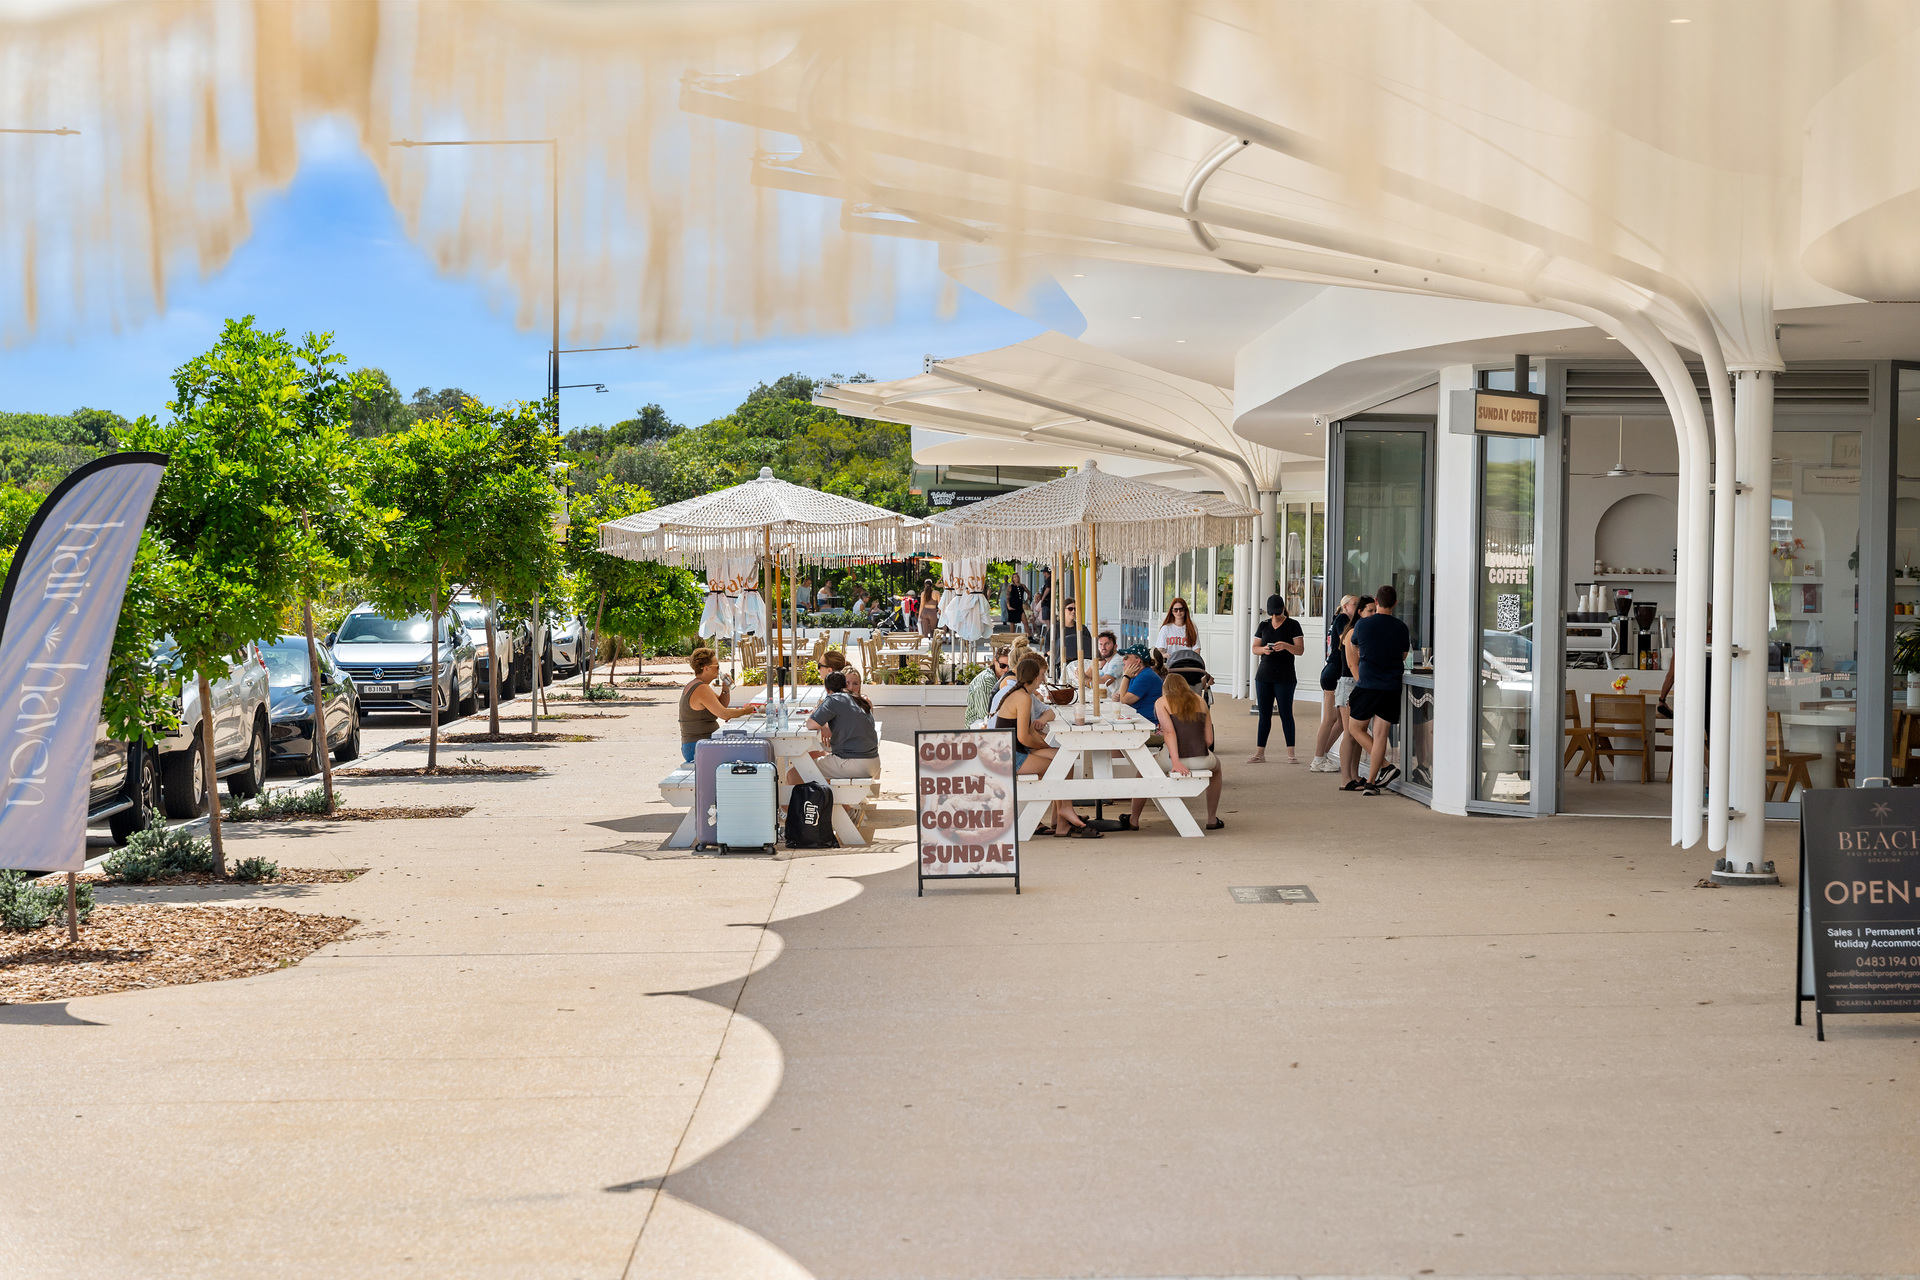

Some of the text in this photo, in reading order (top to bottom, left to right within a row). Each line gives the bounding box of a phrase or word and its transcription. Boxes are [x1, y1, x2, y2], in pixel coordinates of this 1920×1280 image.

[1478, 406, 1537, 424] SUNDAY COFFEE
[43, 520, 125, 614] hair
[1489, 553, 1529, 568] SUNDAY
[1488, 568, 1528, 584] COFFEE
[5, 660, 89, 808] haven
[920, 742, 978, 761] COLD
[920, 776, 986, 795] BREW
[922, 810, 1004, 829] COOKIE
[922, 844, 1014, 864] SUNDAE
[1824, 880, 1909, 904] OPEN
[1827, 928, 1852, 936] Sales
[1865, 927, 1914, 936] Permanent
[1834, 940, 1868, 949] Holiday
[1856, 957, 1885, 966] 0483
[1888, 957, 1906, 966] 194
